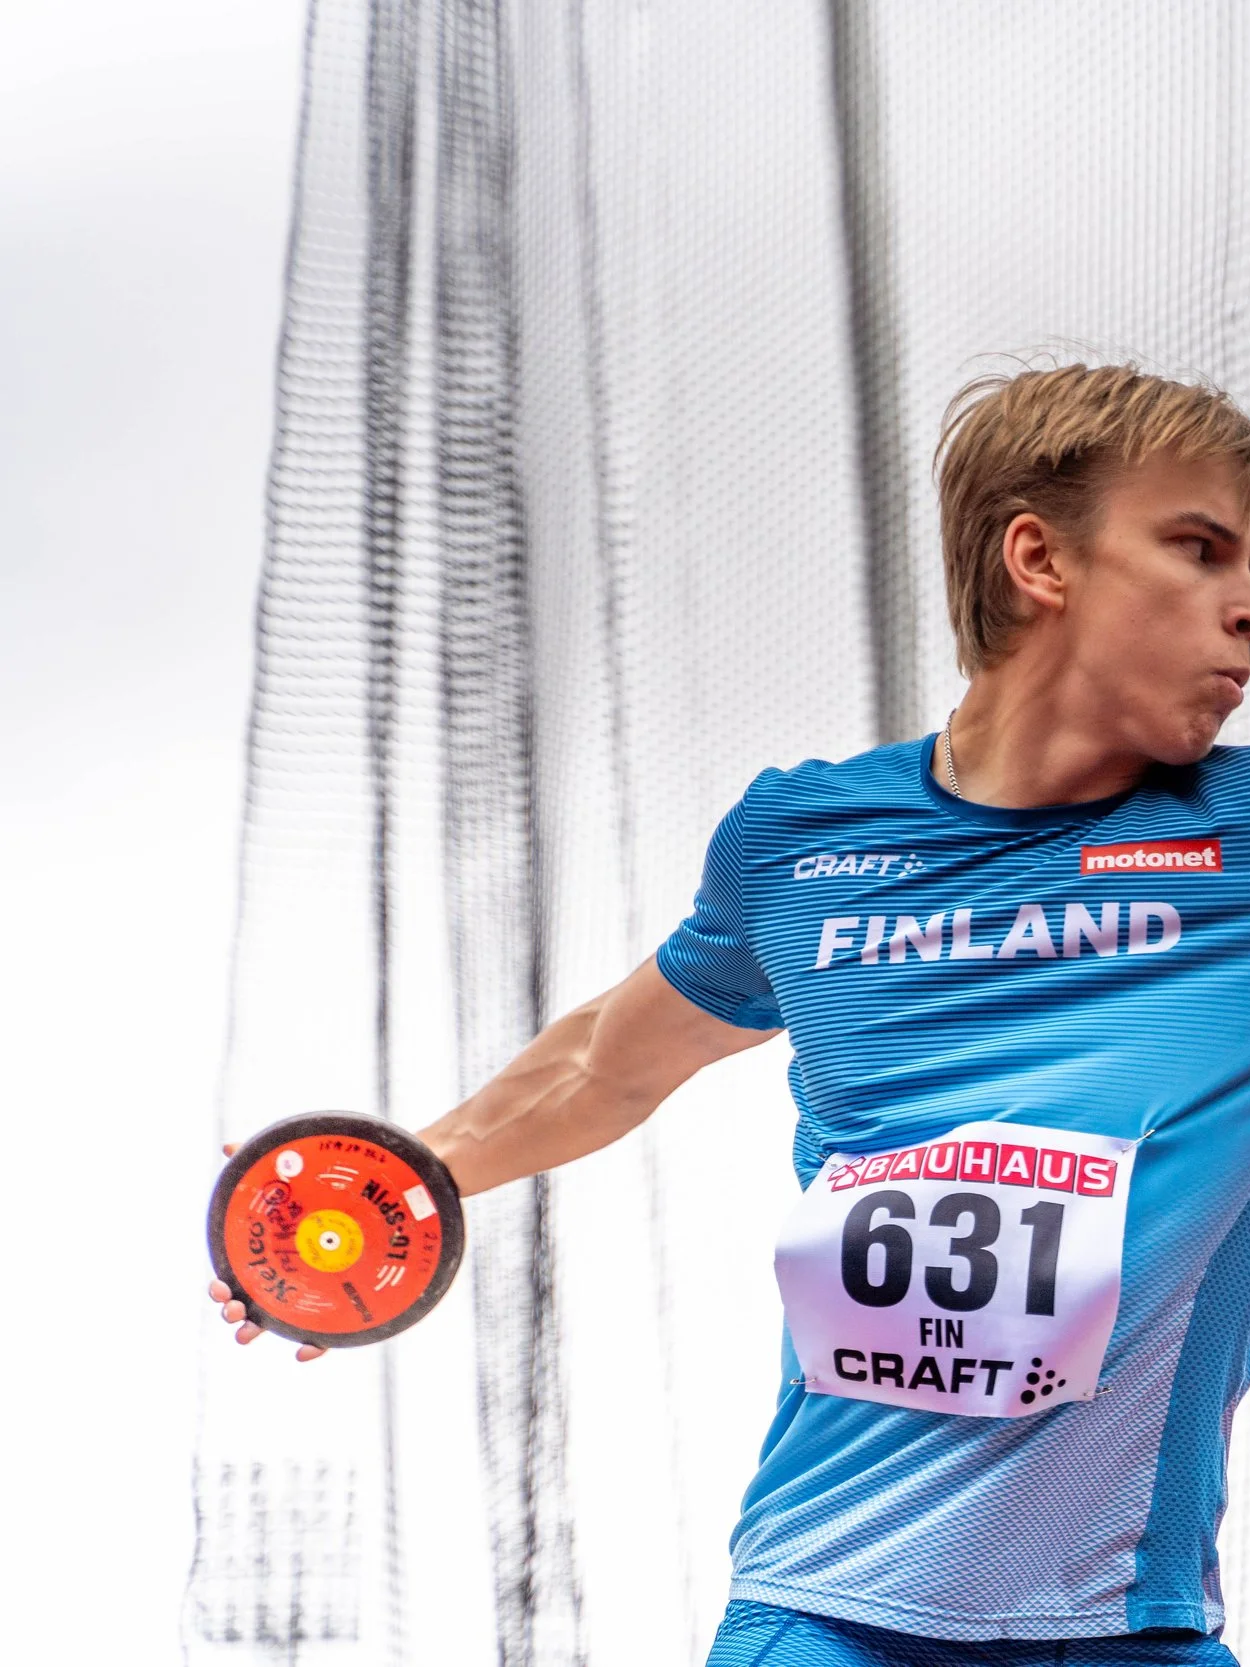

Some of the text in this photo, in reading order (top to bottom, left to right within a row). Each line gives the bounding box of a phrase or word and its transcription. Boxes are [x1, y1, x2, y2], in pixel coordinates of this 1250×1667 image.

[794, 854, 901, 880] CRAFT
[1086, 846, 1216, 869] motonet
[814, 902, 1182, 969] FINLAND
[862, 1142, 1116, 1195] BAUHAUS
[841, 1190, 1065, 1317] 631
[919, 1317, 964, 1348] FIN
[833, 1348, 1014, 1396] CRAFT
